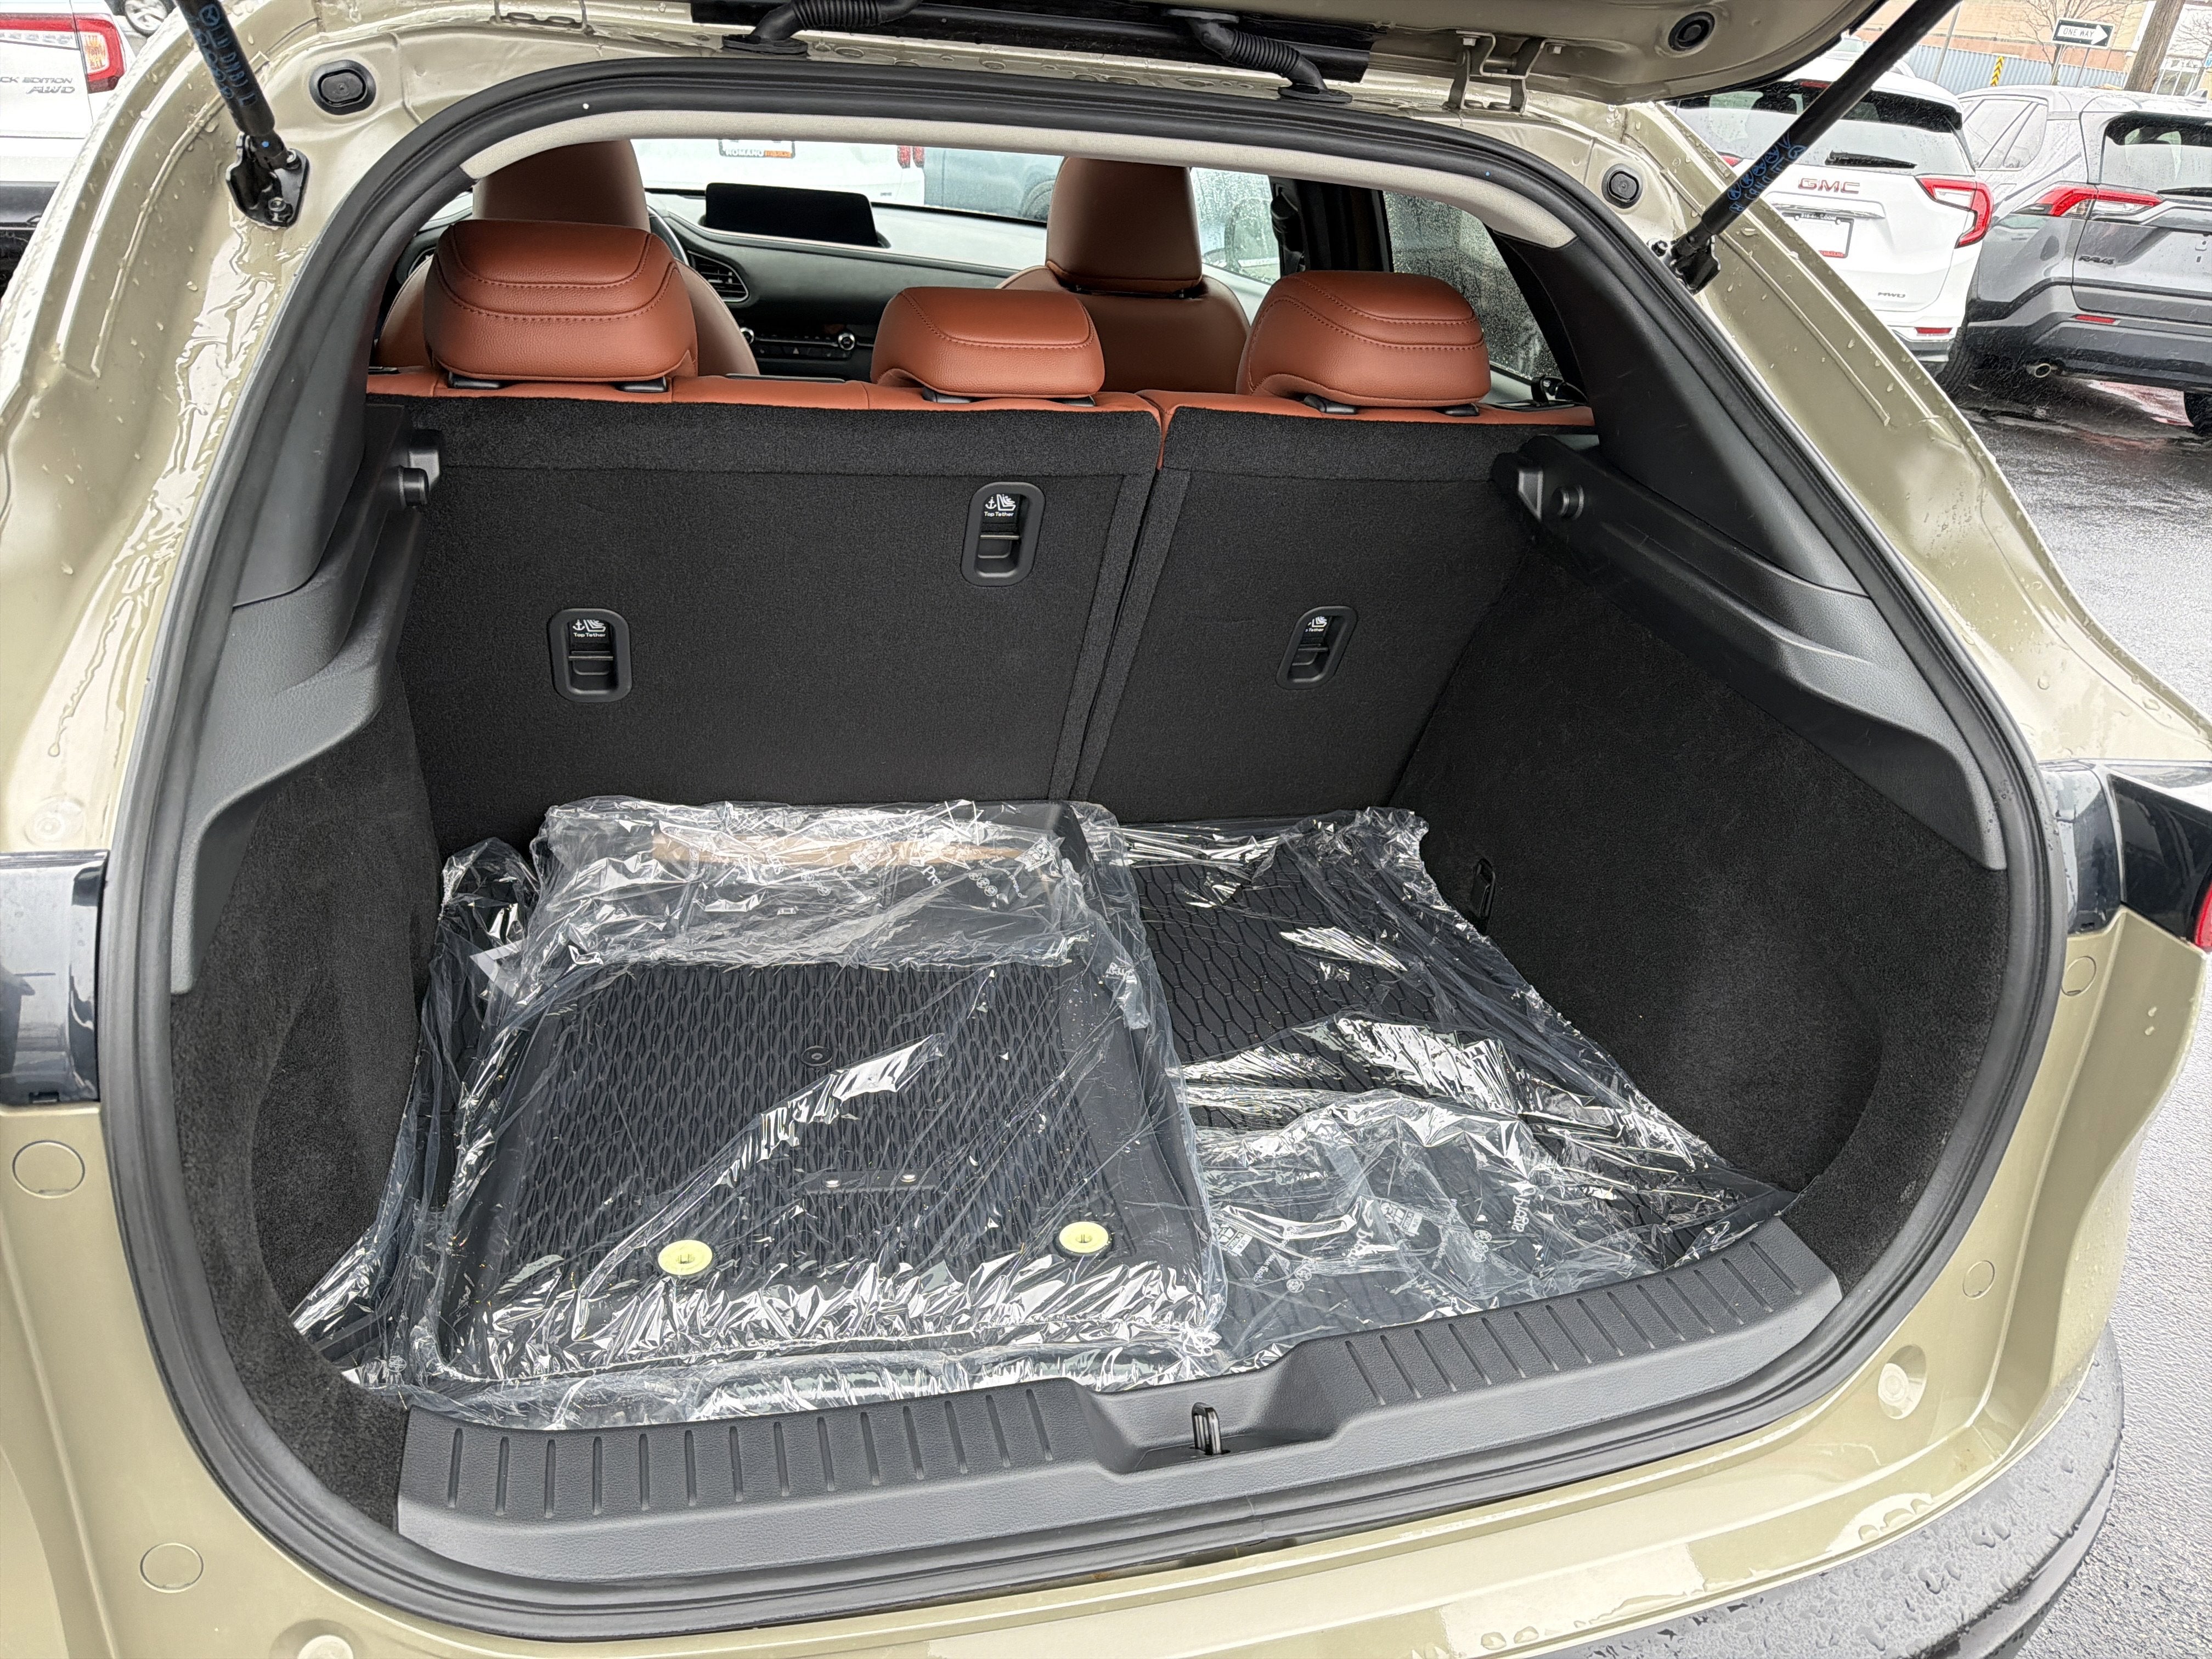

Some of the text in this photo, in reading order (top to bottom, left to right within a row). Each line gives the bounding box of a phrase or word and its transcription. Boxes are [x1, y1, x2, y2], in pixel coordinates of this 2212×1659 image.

[2063, 27, 2095, 38] ONE WAY
[26, 86, 75, 94] AWD
[1798, 178, 1860, 194] GMC
[2078, 256, 2115, 264] RAV4
